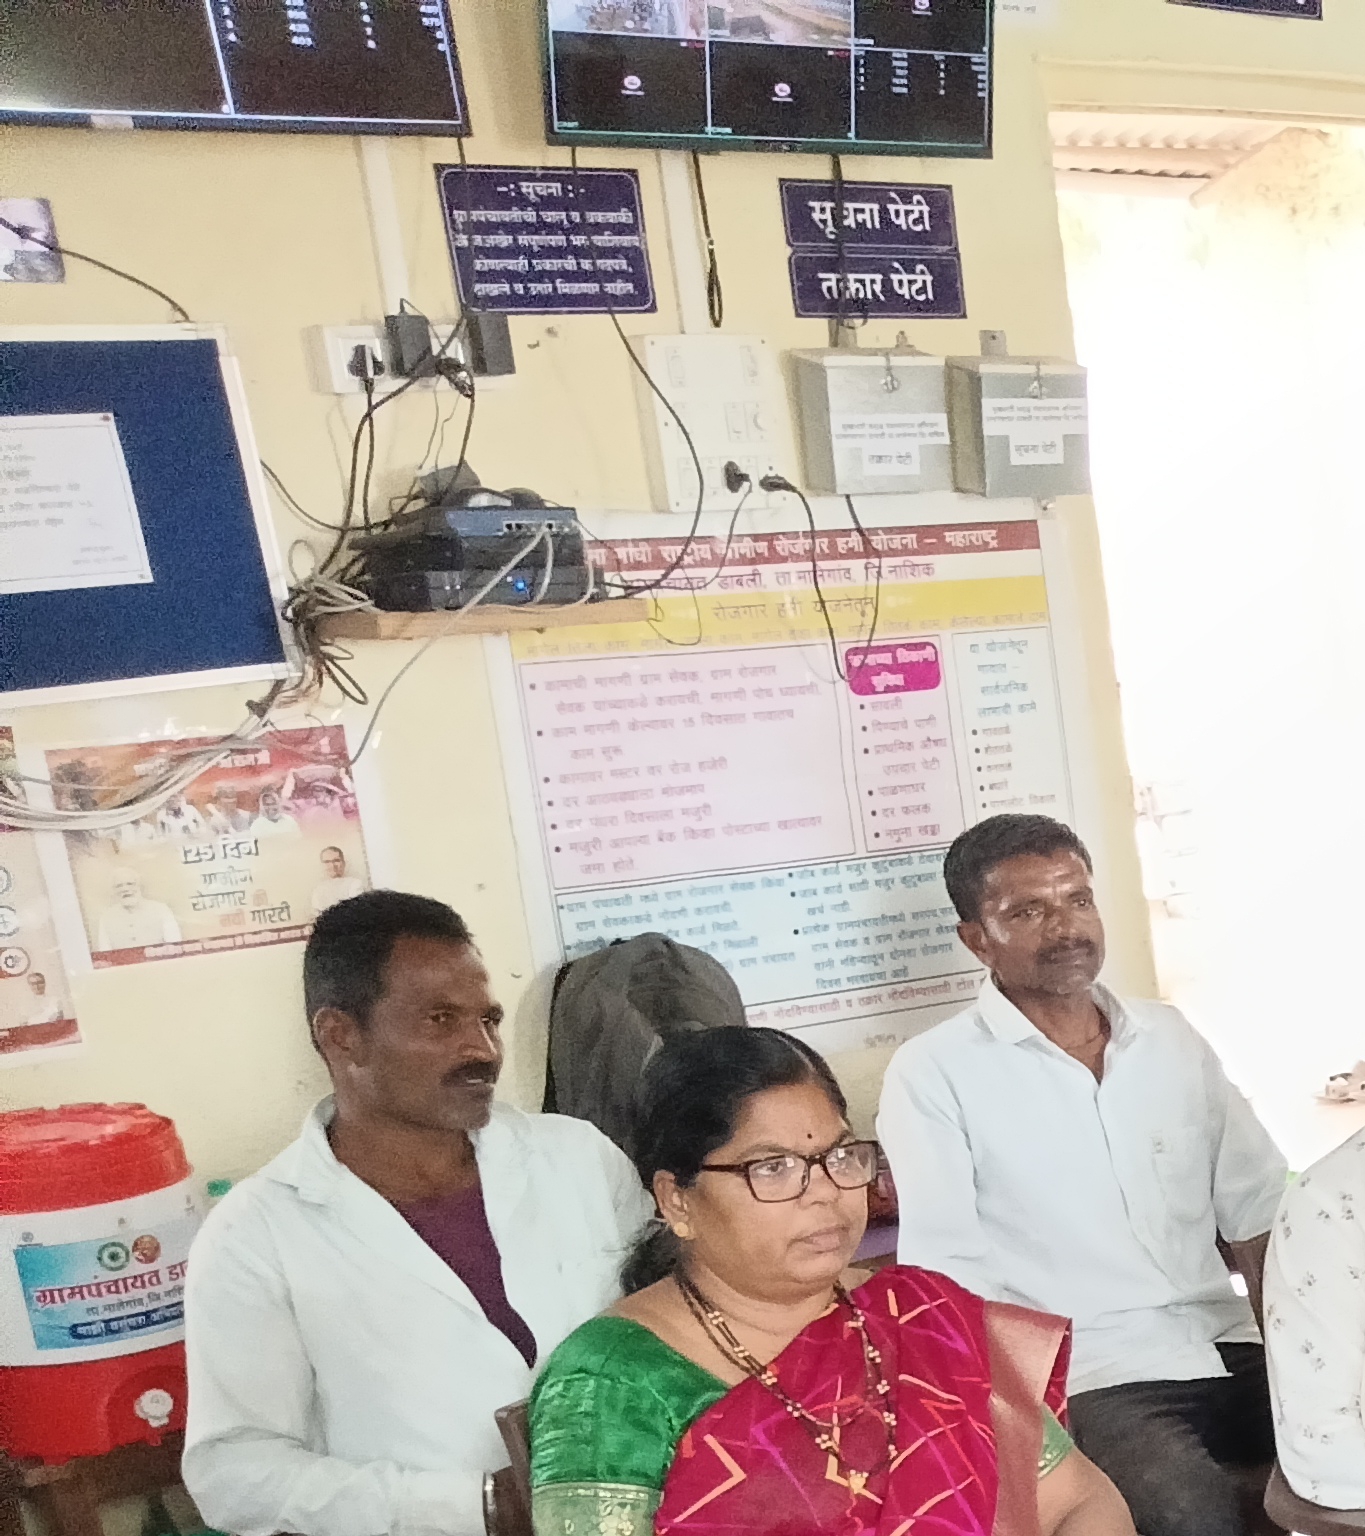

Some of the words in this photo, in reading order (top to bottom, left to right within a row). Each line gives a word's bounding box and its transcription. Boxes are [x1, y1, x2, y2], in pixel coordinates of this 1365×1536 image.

[518, 182, 562, 202] सूचना
[808, 200, 881, 239] सूचना
[886, 191, 931, 232] पेटी
[889, 261, 934, 302] पेटी
[837, 533, 864, 553] हमी
[871, 530, 918, 550] योजना
[943, 528, 1000, 549] महाराष्ट्र
[887, 559, 936, 580] नाशिक
[711, 602, 770, 620] रोजगार
